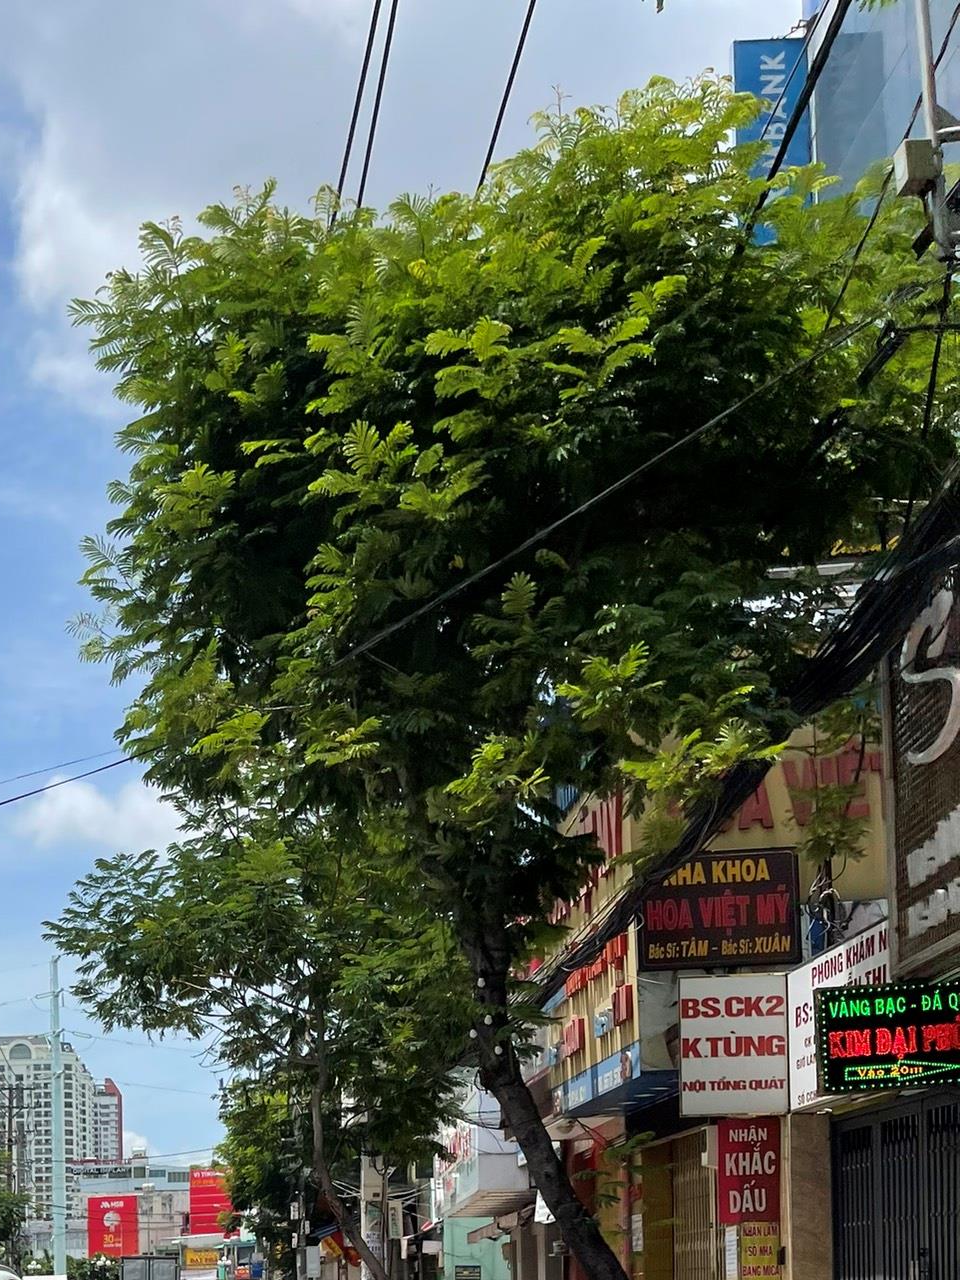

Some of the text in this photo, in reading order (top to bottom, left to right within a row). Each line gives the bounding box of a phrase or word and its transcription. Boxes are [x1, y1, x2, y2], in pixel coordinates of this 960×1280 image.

[711, 857, 771, 884] KHOA
[646, 883, 790, 937] HOA VIỆT MỸ
[680, 936, 709, 958] TÂM
[753, 931, 791, 954] XUÂN
[846, 935, 875, 969] KHÁM
[681, 995, 785, 1019] BS.CK2
[828, 995, 872, 1019] VÀNG
[875, 996, 907, 1018] BẠC
[921, 989, 943, 1011] ĐÁ
[681, 1030, 786, 1059] K.TÙNG
[828, 1028, 872, 1059] KIM
[875, 1024, 918, 1060] ĐẠI
[890, 1065, 923, 1075] 20m
[682, 1078, 707, 1094] NỘI
[729, 1124, 768, 1145] NHẬN
[724, 1142, 776, 1177] KHẮC
[729, 1179, 767, 1214] DẤU
